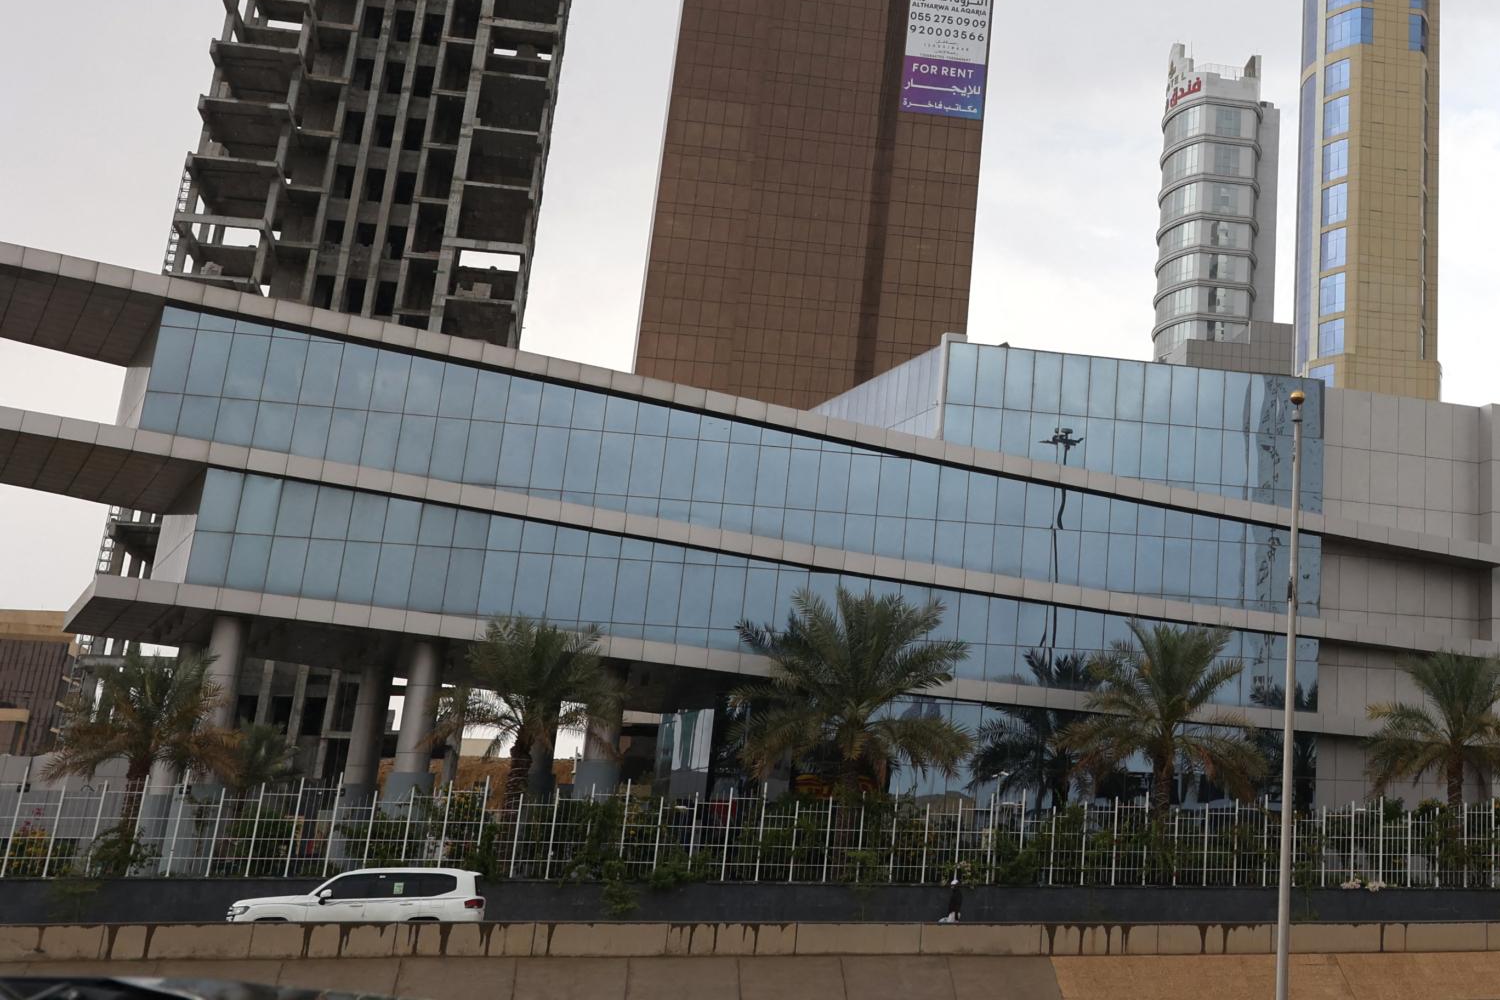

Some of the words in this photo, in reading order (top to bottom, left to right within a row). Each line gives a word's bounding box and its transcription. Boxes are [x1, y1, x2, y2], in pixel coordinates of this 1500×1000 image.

[912, 1, 949, 12] ALTHARWA
[910, 11, 931, 22] 055
[934, 14, 954, 25] 275
[909, 24, 985, 42] 920003566
[912, 63, 938, 75] FOR
[941, 66, 974, 79] RENT
[903, 78, 981, 98] للإيجار
[1170, 76, 1202, 108] فندق
